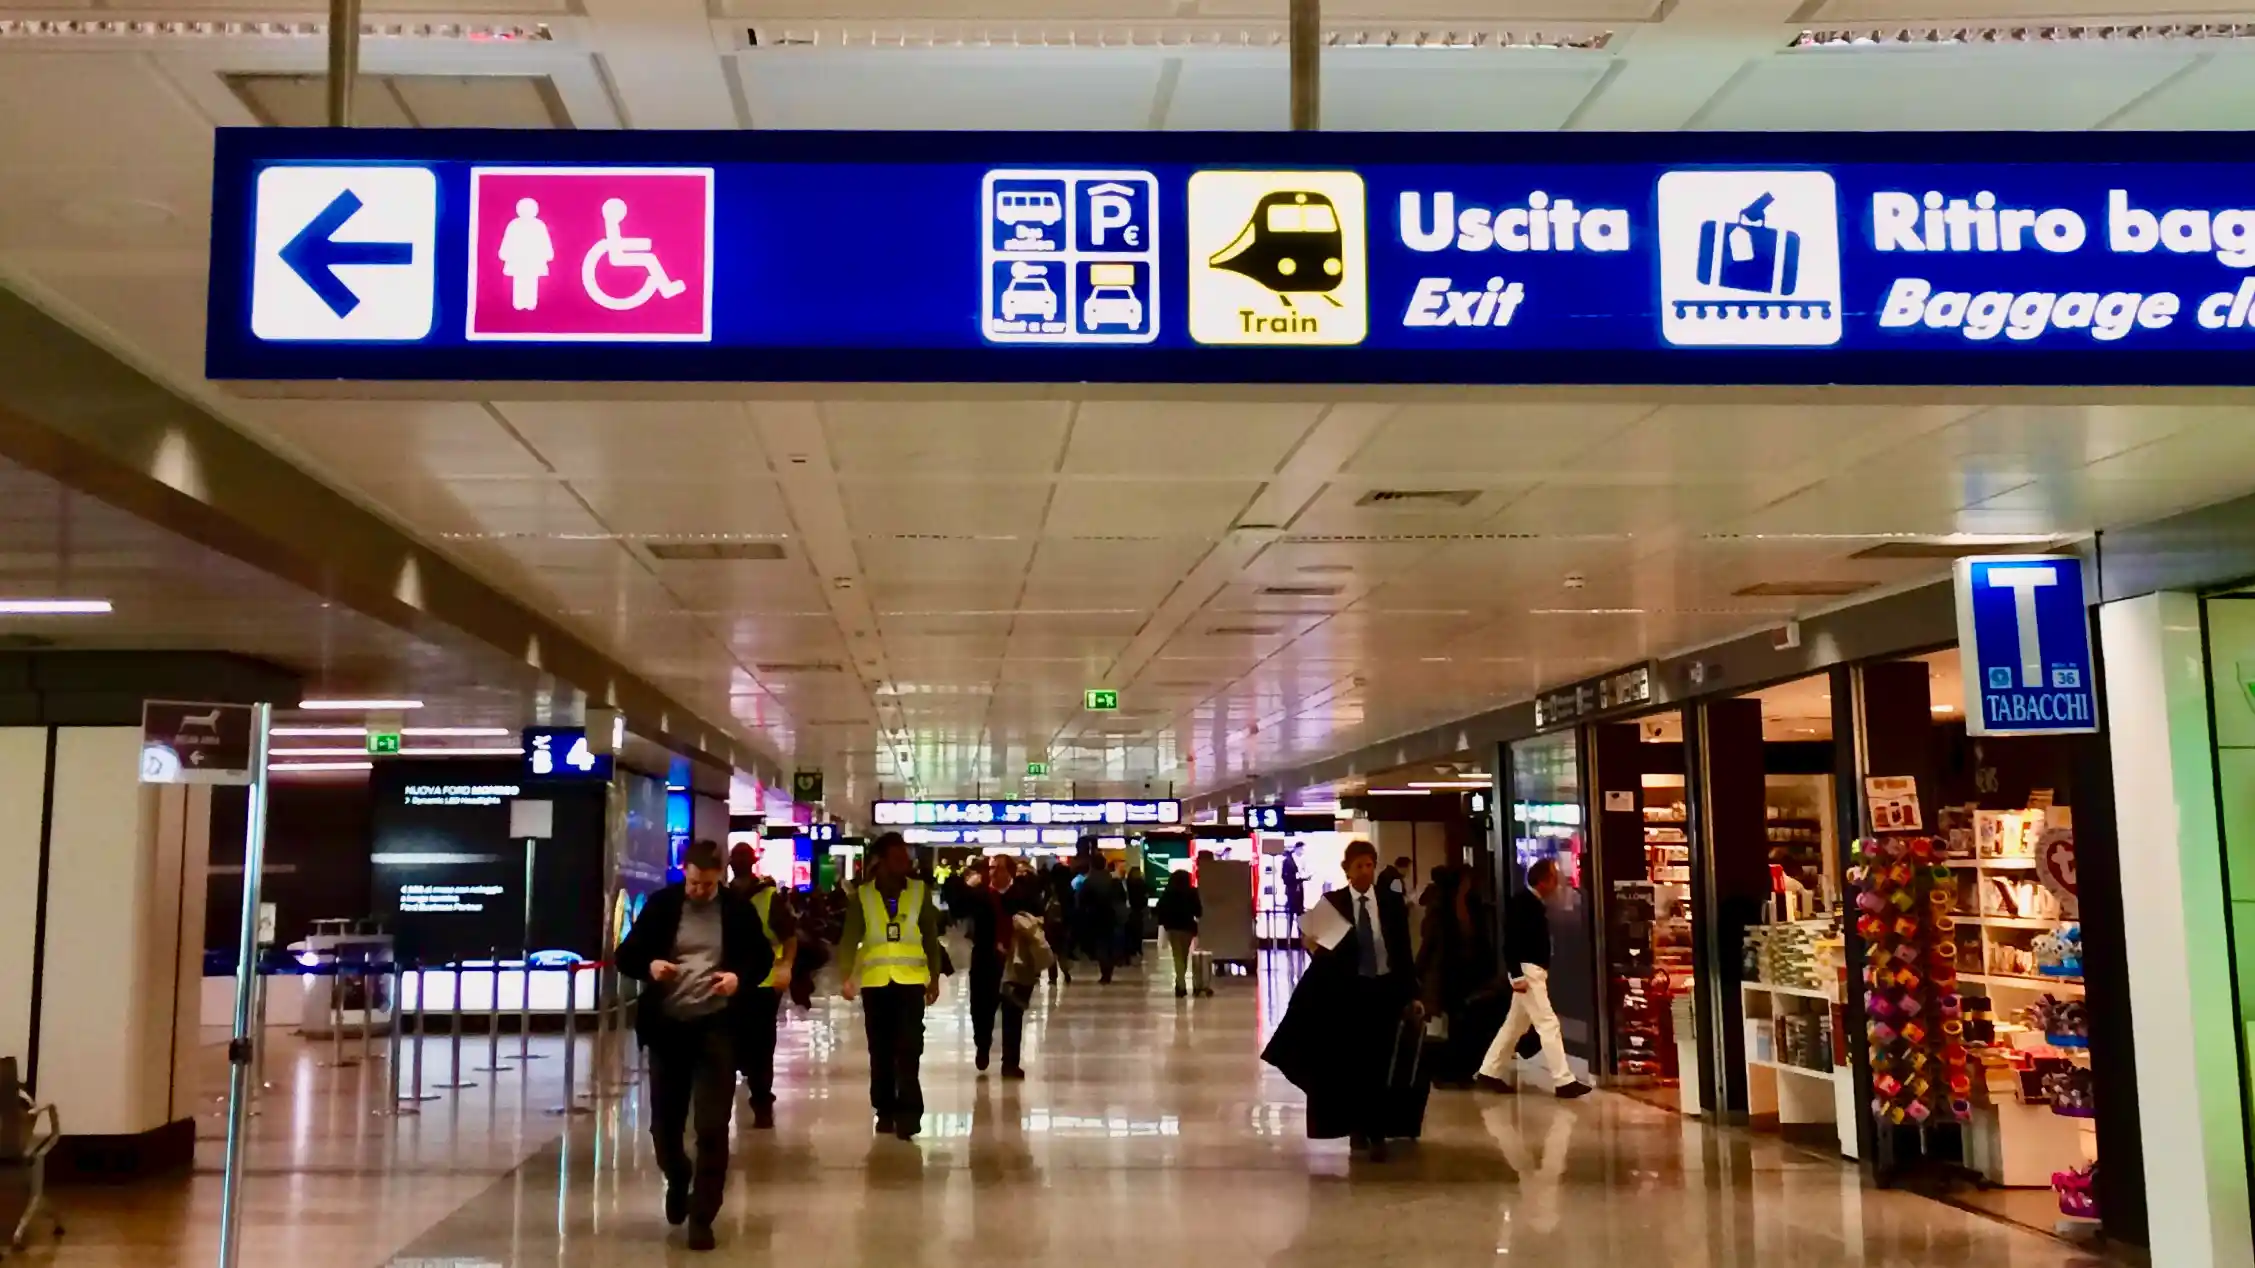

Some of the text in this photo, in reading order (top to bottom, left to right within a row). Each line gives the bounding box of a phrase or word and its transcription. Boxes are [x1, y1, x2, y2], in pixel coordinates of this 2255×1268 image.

[1400, 190, 1629, 252] Uscita
[1873, 189, 2255, 268] Ritiro bag
[1239, 309, 1318, 333] Train
[1402, 276, 1525, 327] Exit
[1879, 276, 2255, 341] Baggage cl
[1987, 567, 2058, 688] T
[2058, 672, 2076, 686] 36
[1986, 693, 2090, 723] TABACCHI
[566, 737, 596, 771] 4
[404, 785, 442, 796] NUOVA
[442, 785, 471, 796] FORD
